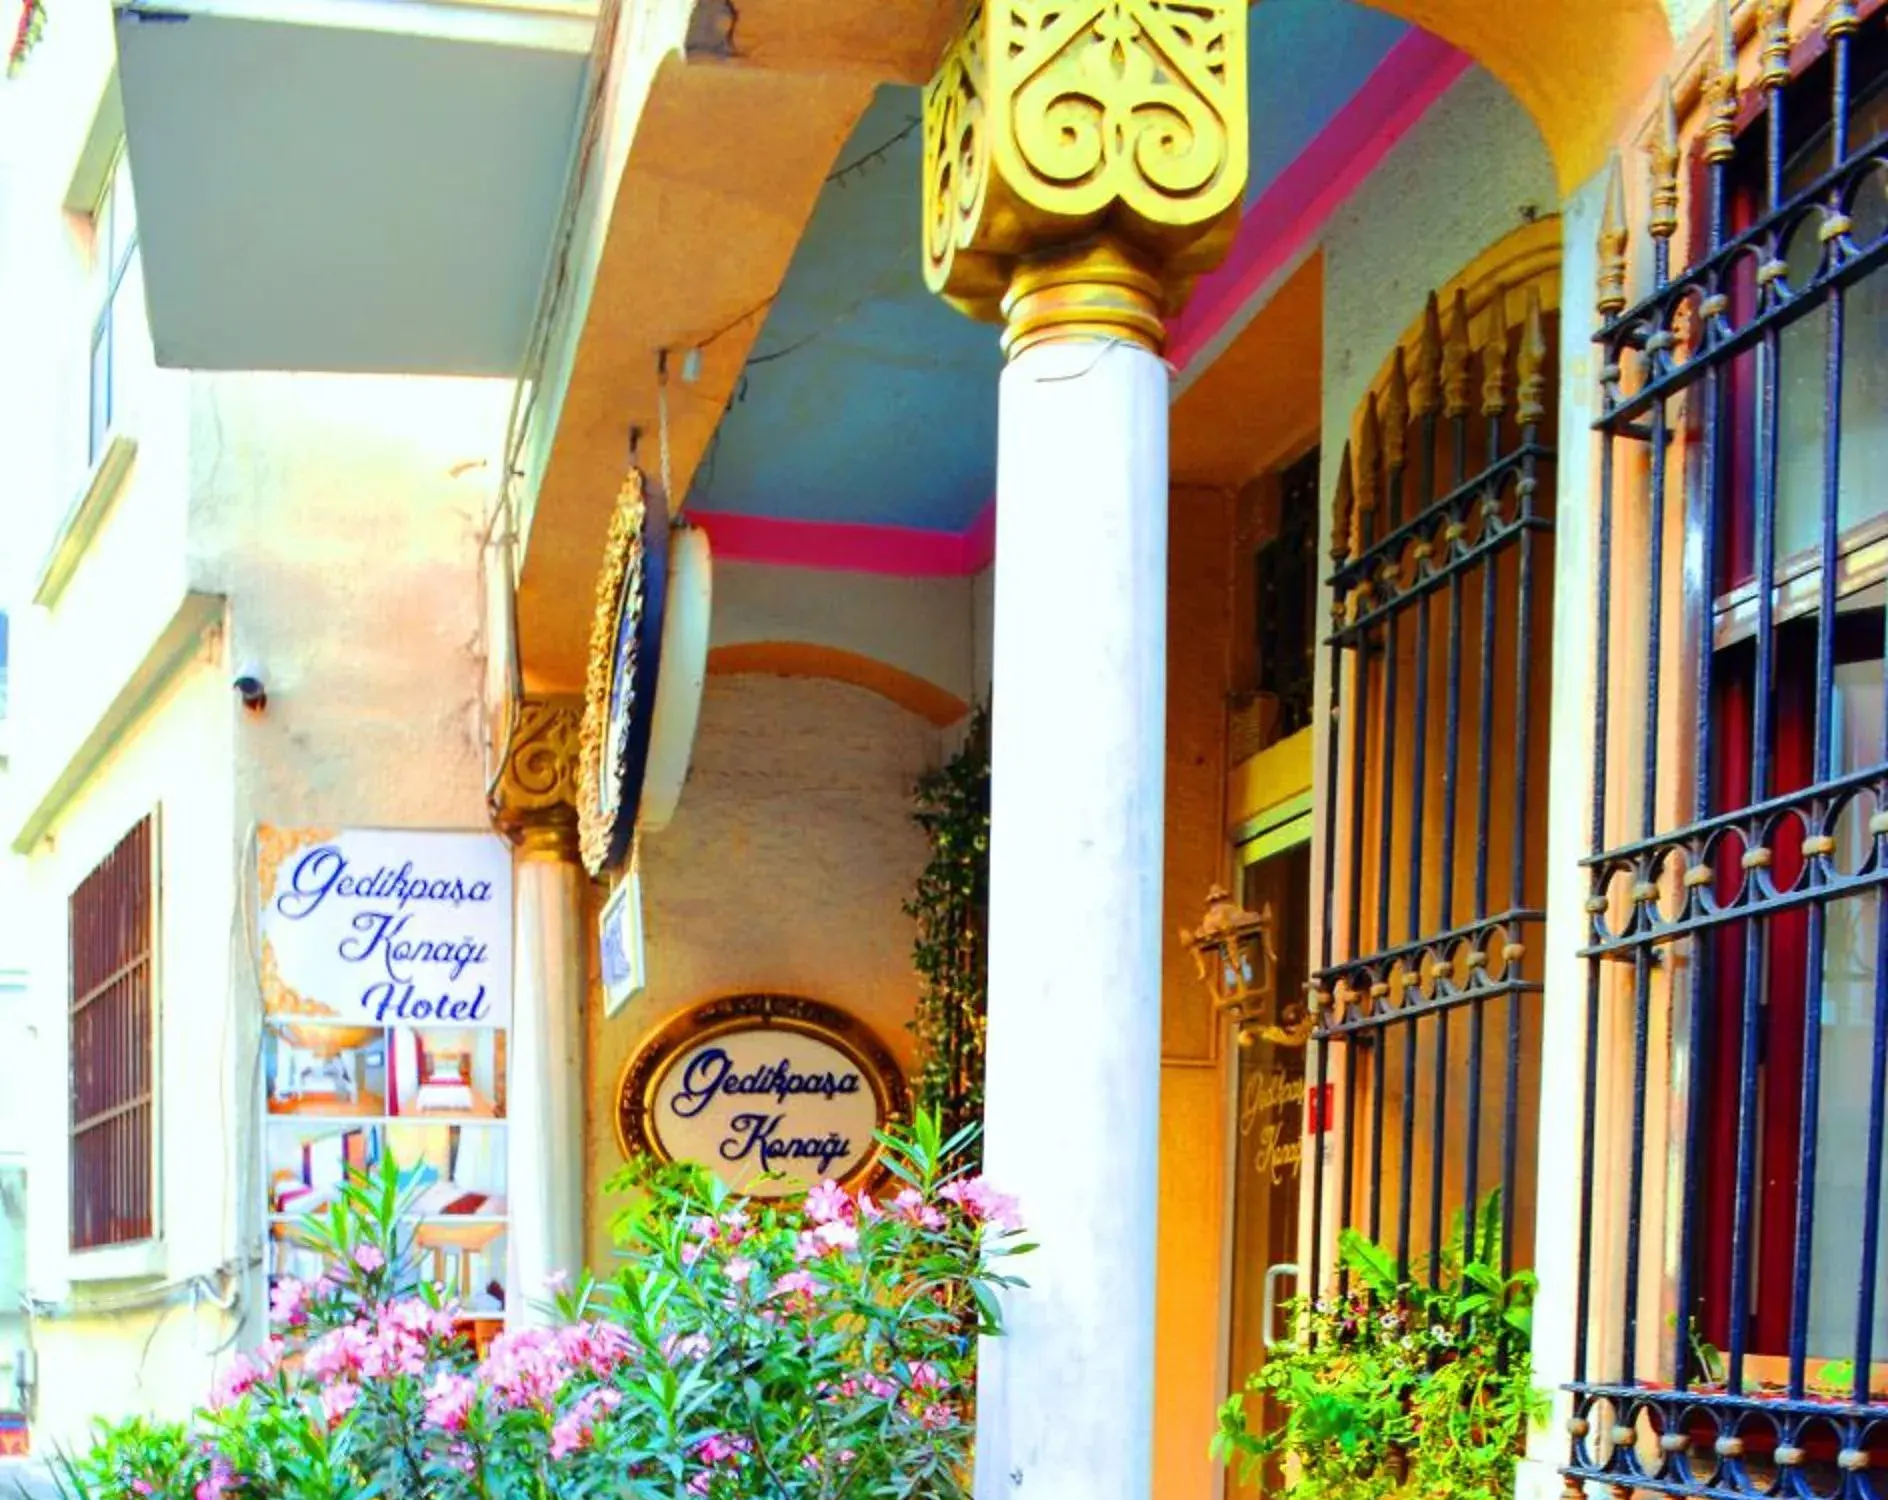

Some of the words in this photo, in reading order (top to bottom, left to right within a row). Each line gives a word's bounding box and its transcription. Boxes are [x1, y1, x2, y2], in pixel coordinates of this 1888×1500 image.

[277, 846, 492, 920] Gedikpaşa
[338, 912, 488, 984] Konağı
[361, 982, 491, 1022] Hotel
[671, 1047, 860, 1118] Gedikpaşa
[719, 1113, 850, 1180] Konağı
